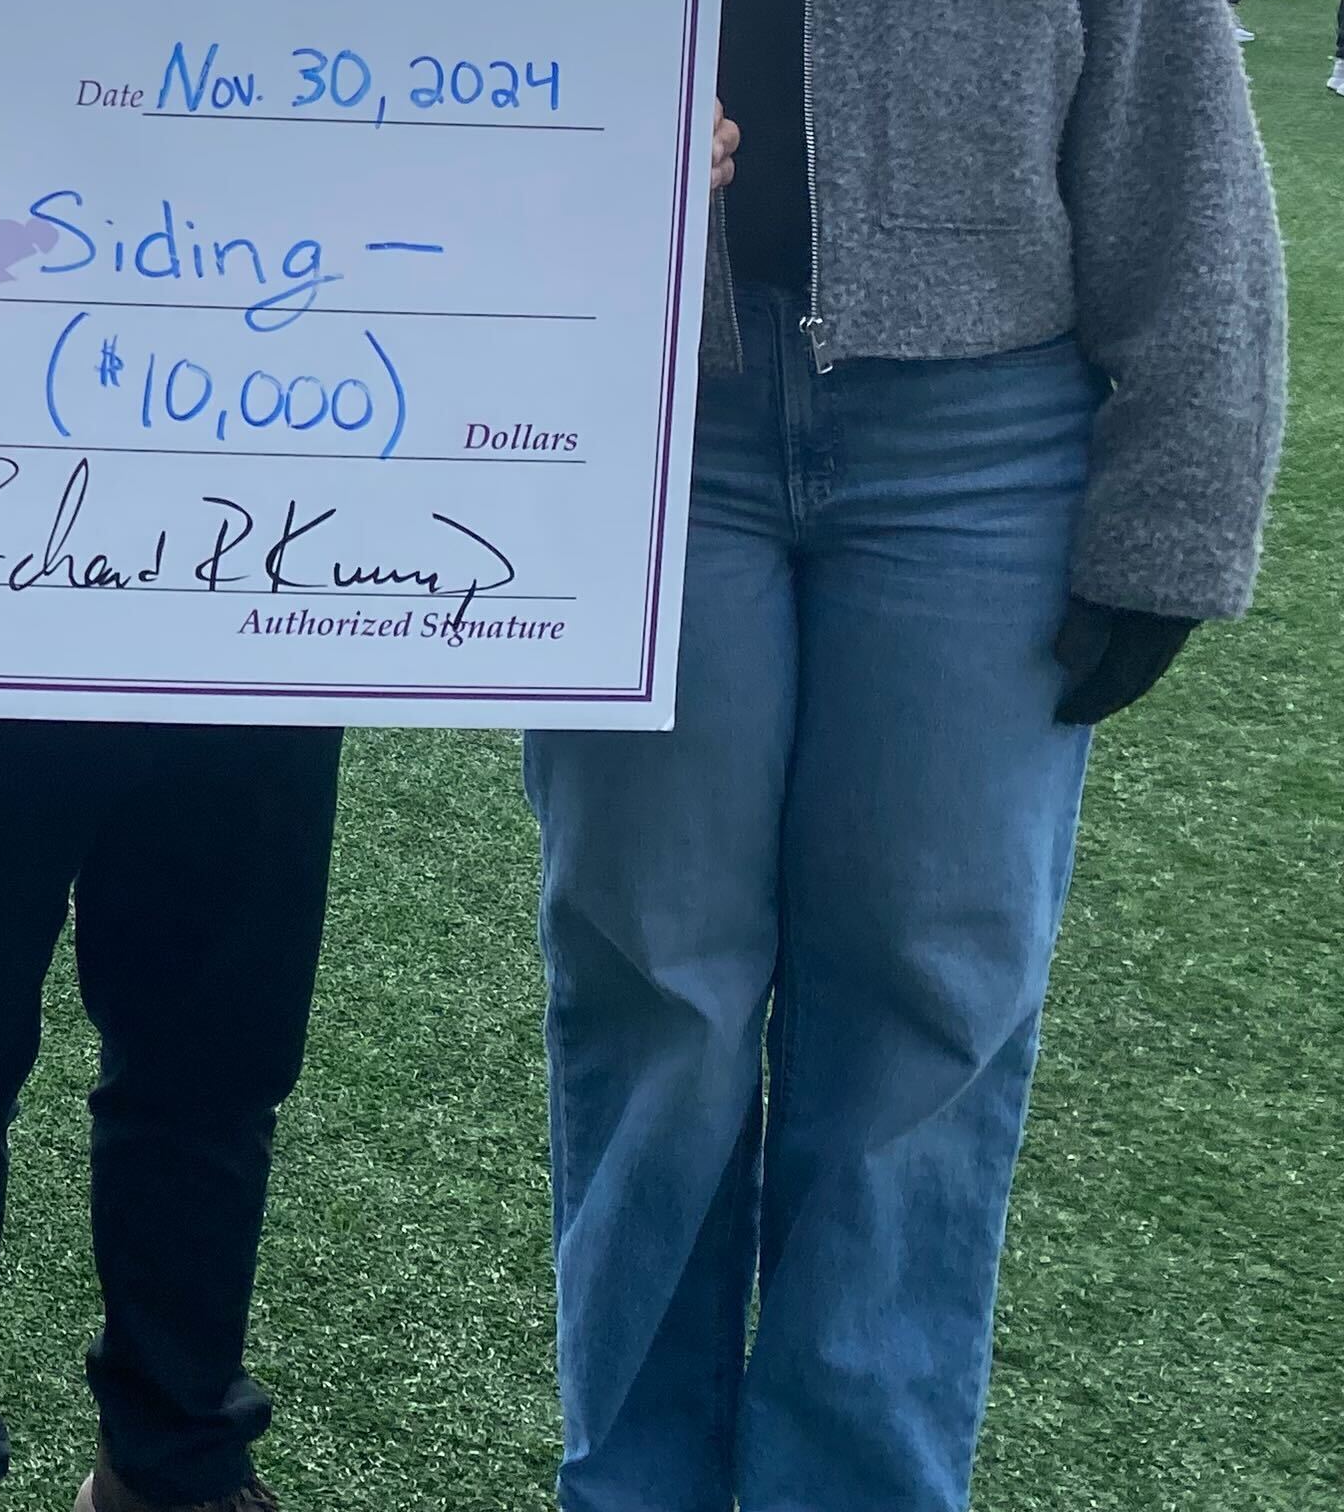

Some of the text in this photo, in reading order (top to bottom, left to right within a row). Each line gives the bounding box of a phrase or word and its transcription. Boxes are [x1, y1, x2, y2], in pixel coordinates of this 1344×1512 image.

[76, 79, 144, 109] Date
[156, 41, 561, 130] Nov. 30, 2024
[29, 190, 346, 333] Siding
[45, 310, 407, 460] ($10,000)
[463, 423, 580, 453] Dollars
[237, 607, 566, 648] Authorized Signature
